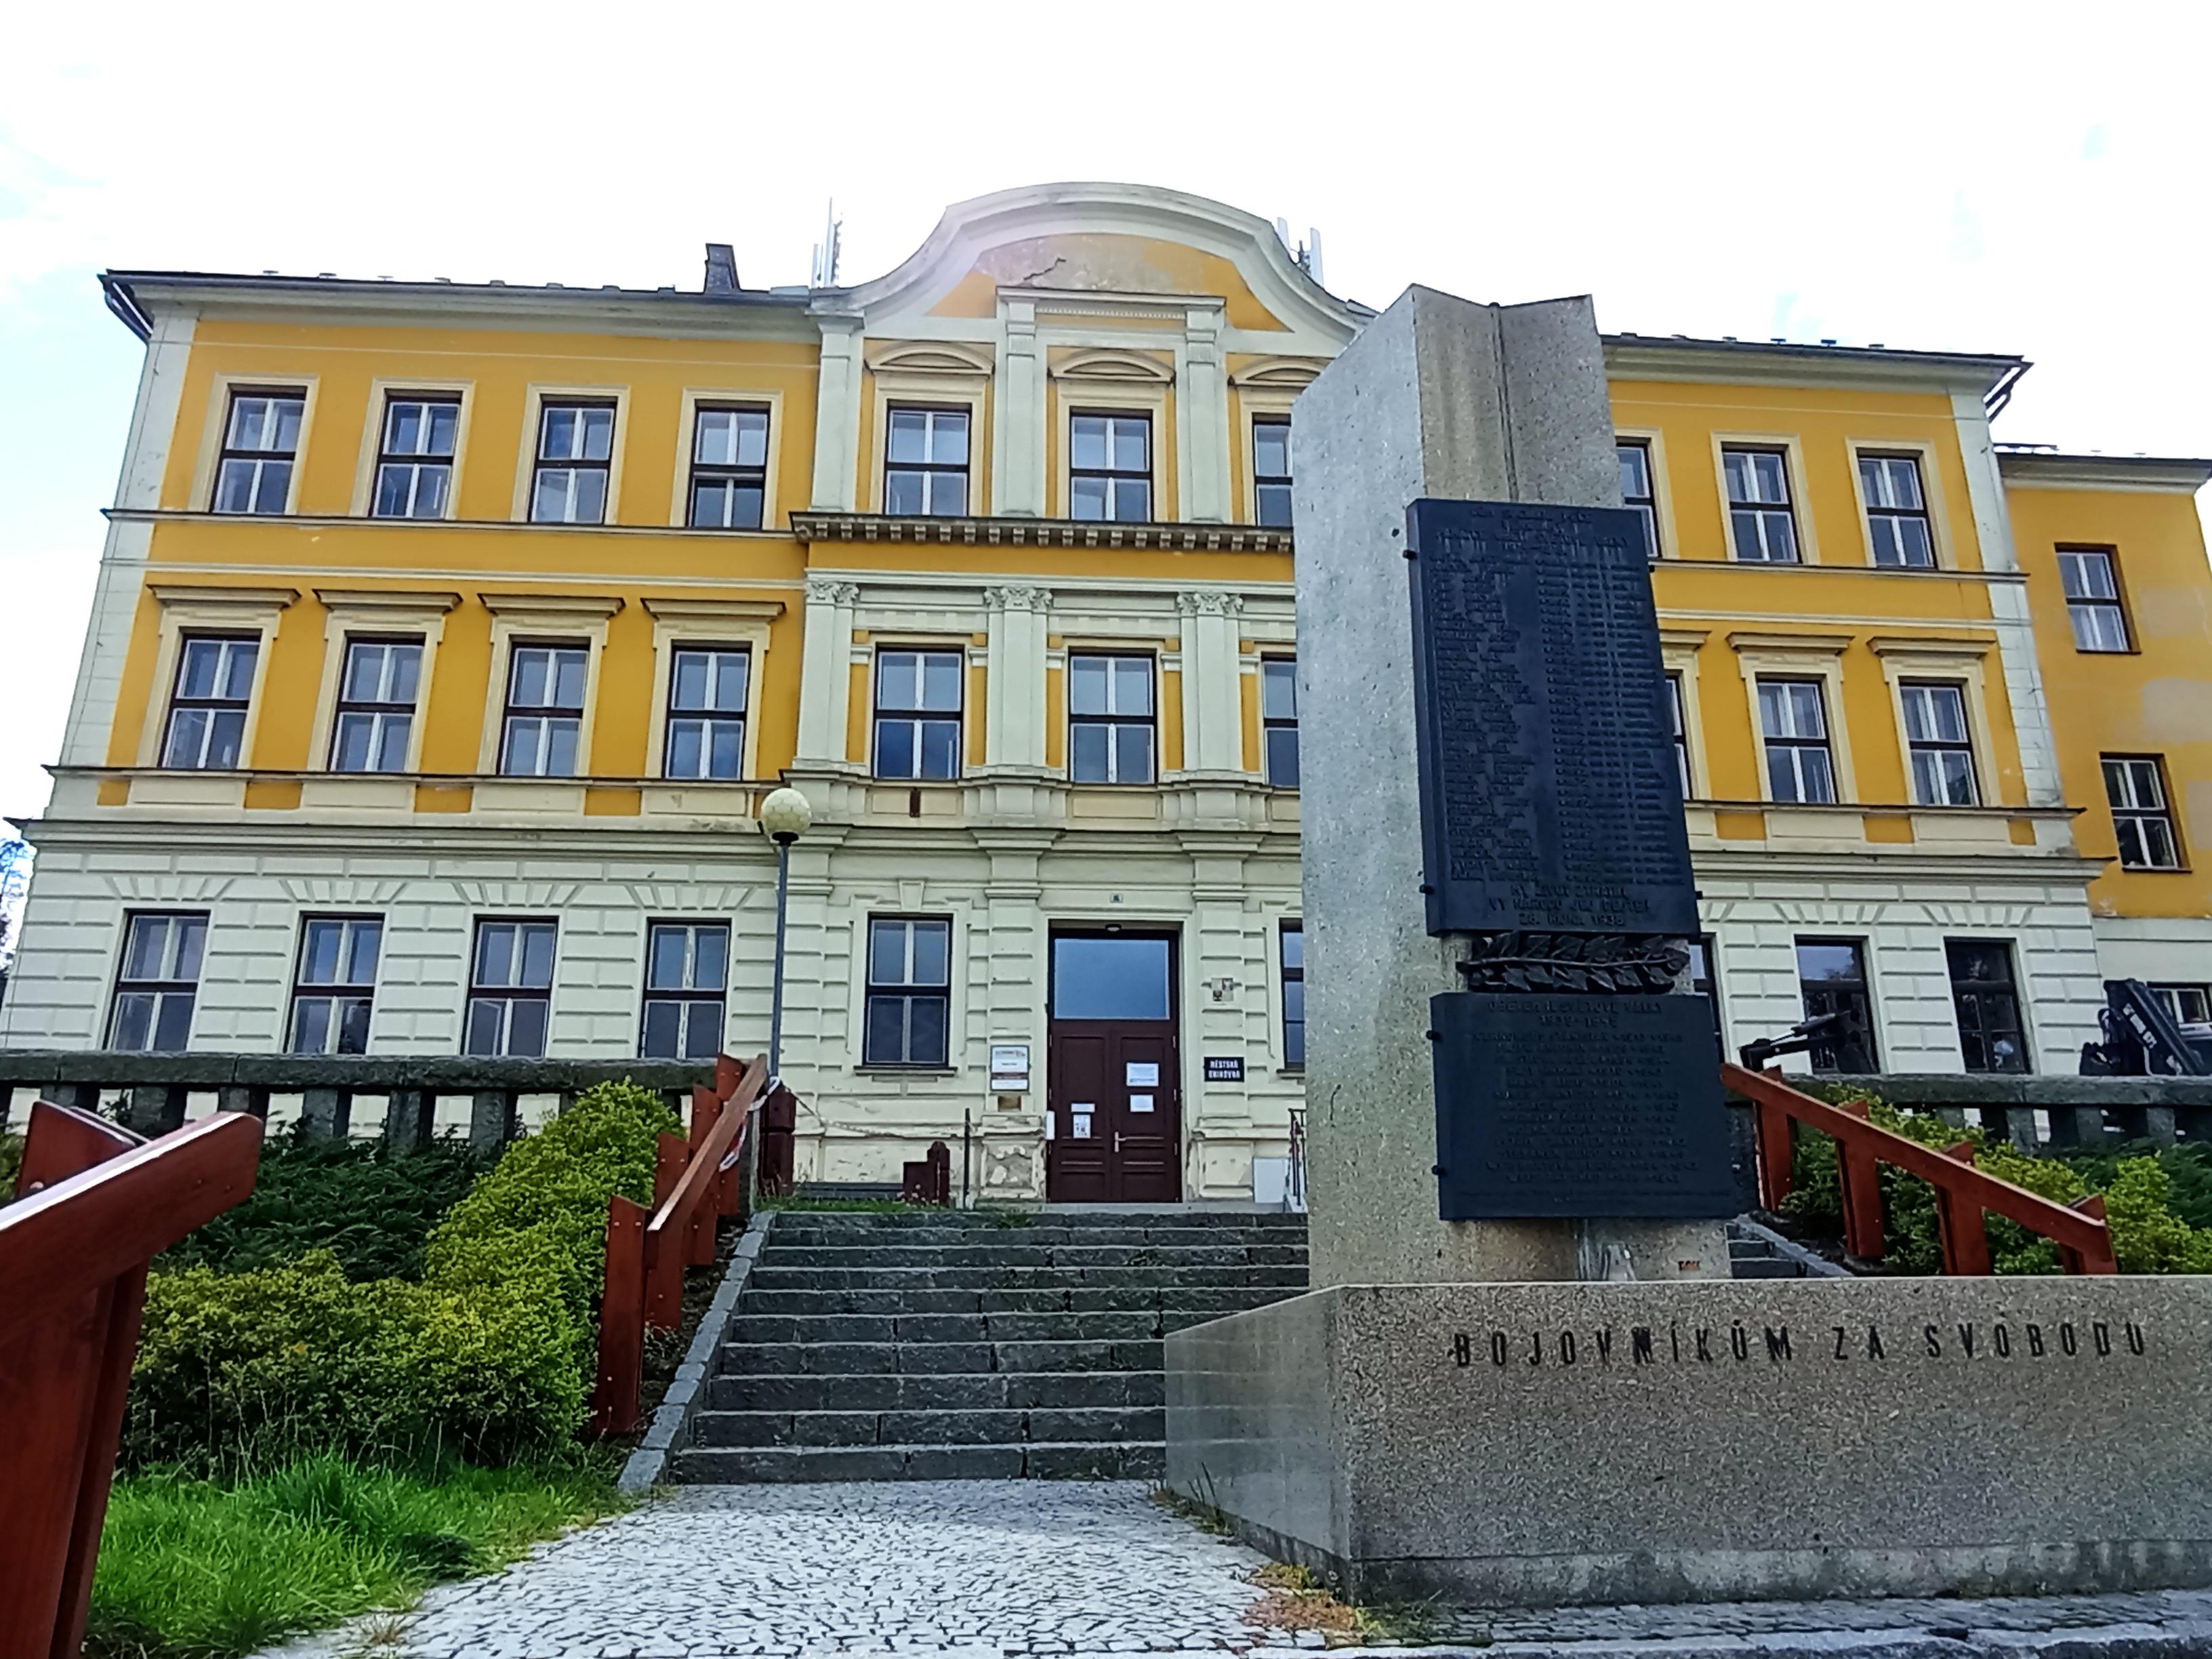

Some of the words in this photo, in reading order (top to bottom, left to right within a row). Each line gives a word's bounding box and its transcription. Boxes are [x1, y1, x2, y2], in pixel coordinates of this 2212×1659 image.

[1454, 1319, 1793, 1367] BOJOVNÍKŮM
[1831, 1325, 1885, 1361] ZA
[1923, 1322, 2146, 1357] SVOBODU
